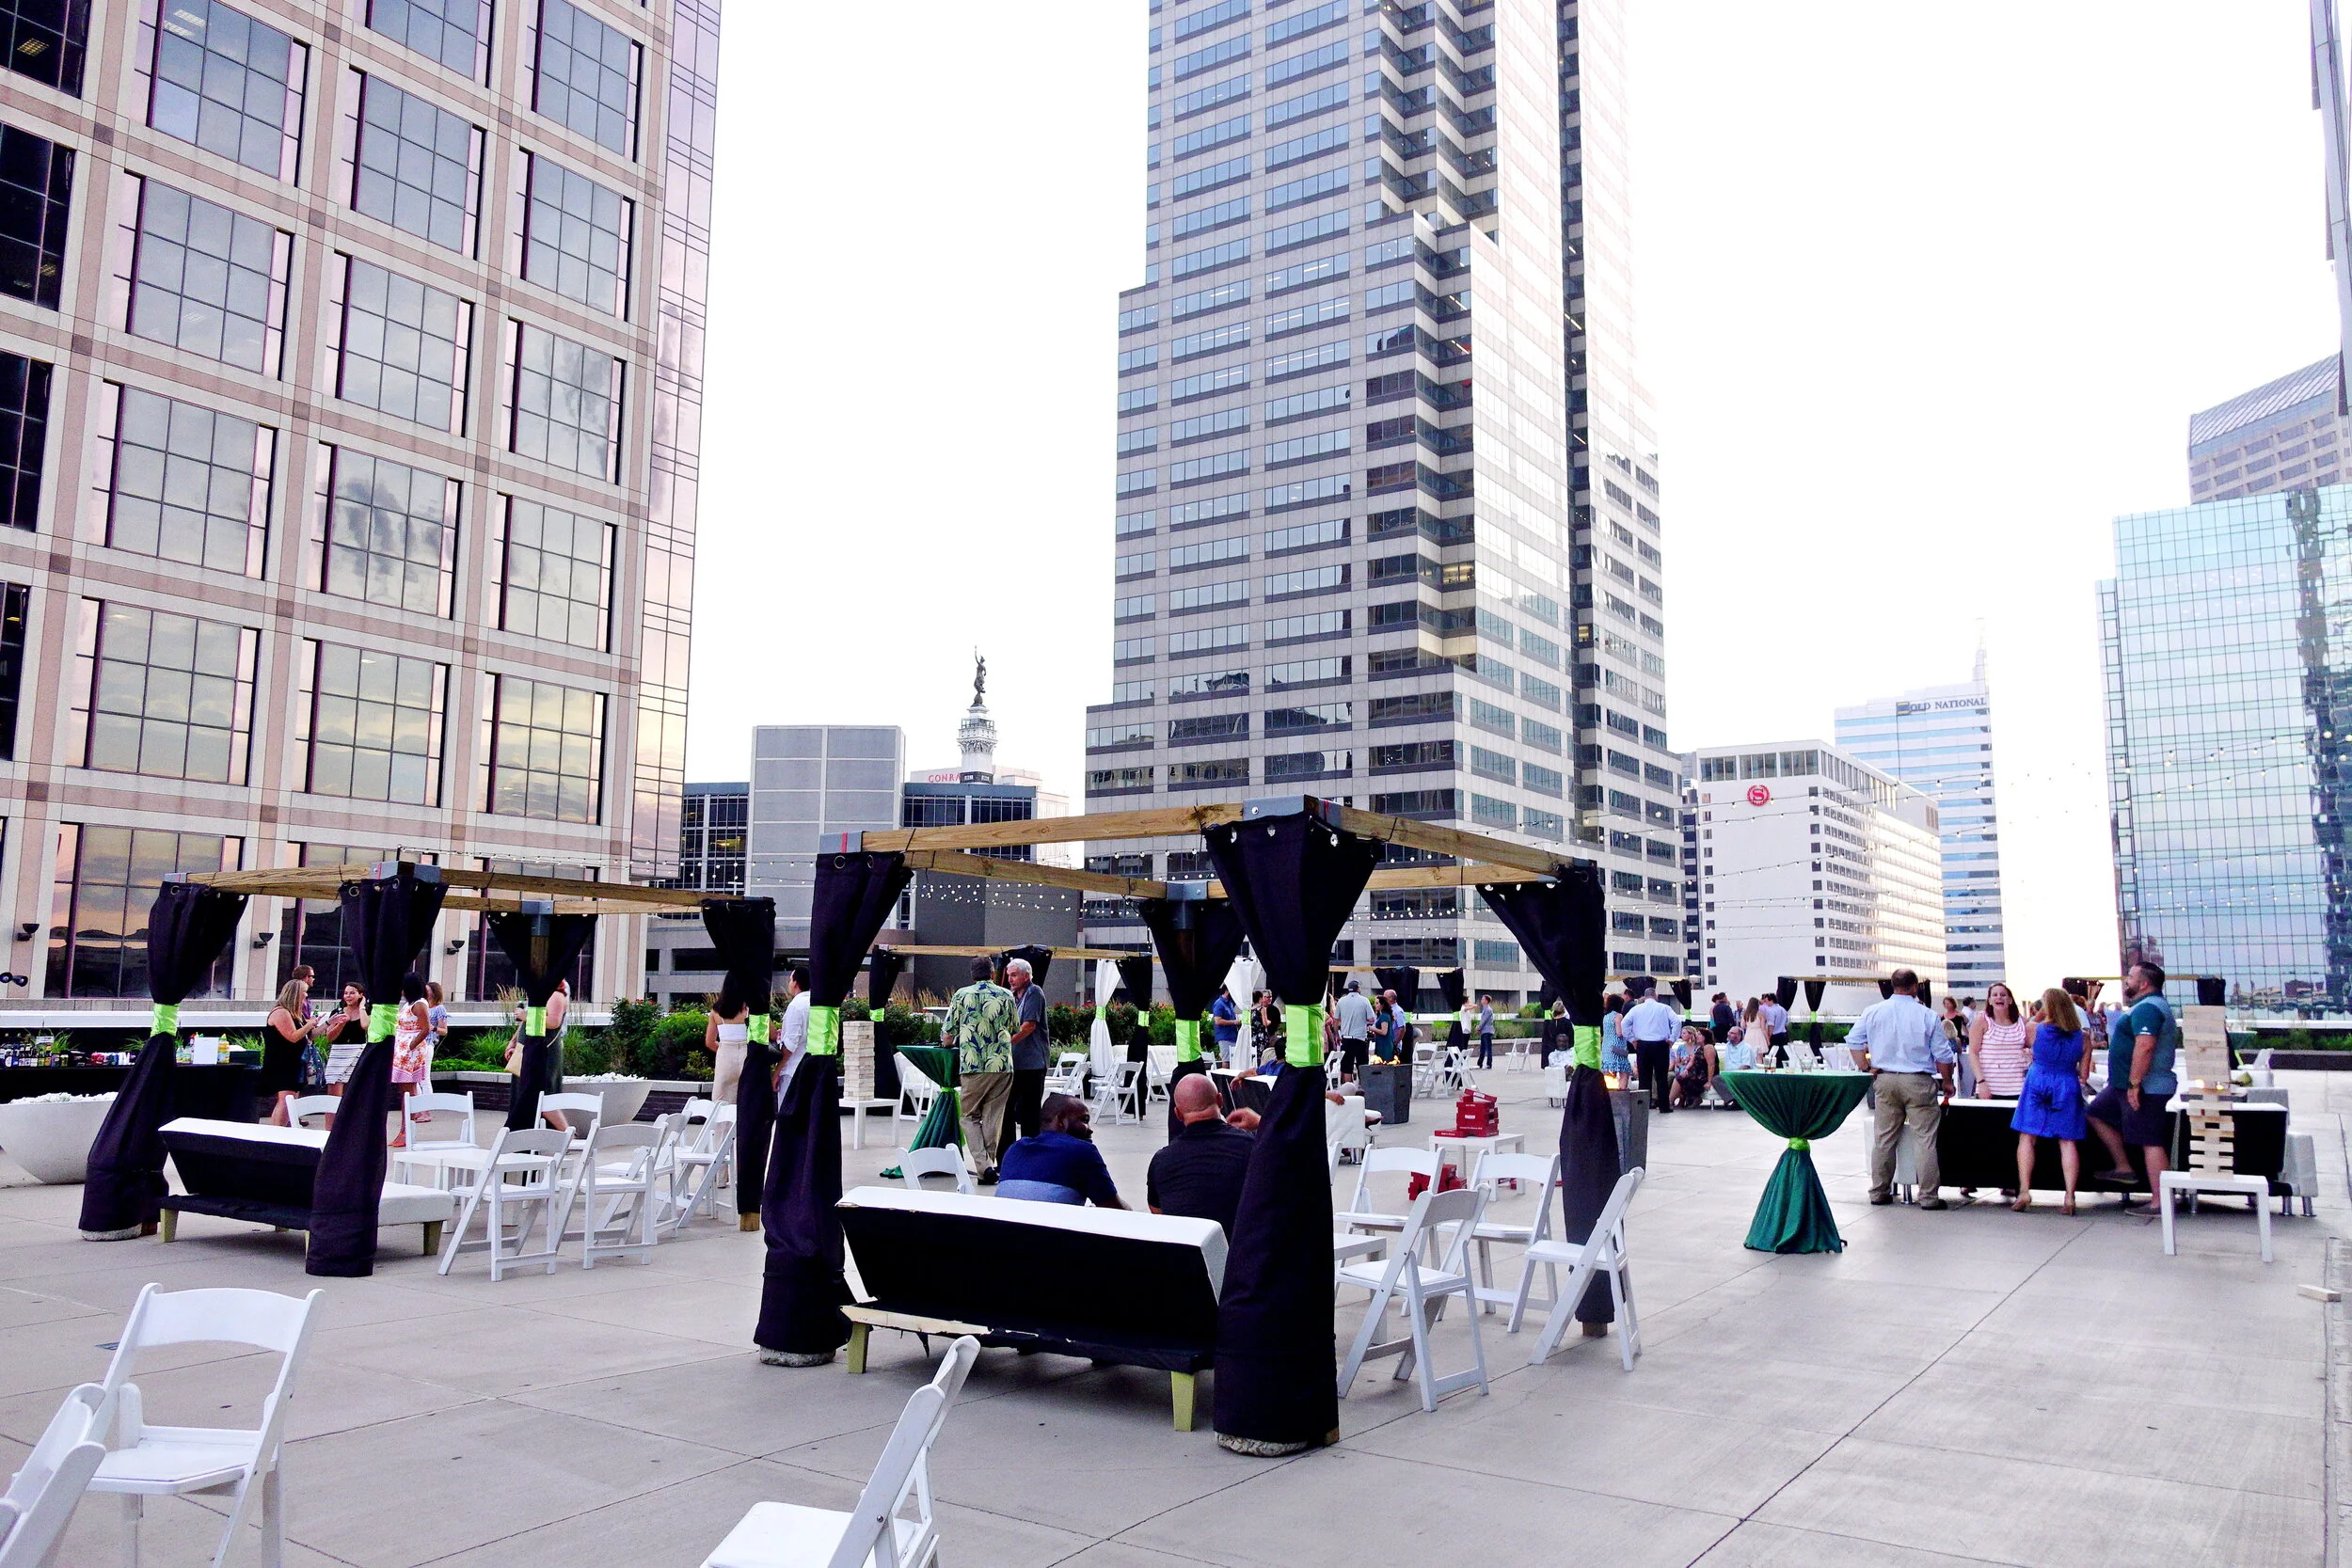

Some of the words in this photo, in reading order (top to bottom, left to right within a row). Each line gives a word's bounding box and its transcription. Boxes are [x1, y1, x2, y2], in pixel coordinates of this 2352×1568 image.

[1909, 702, 1931, 713] OLD
[1934, 697, 1987, 710] NATIONAL
[928, 772, 961, 784] CONRA
